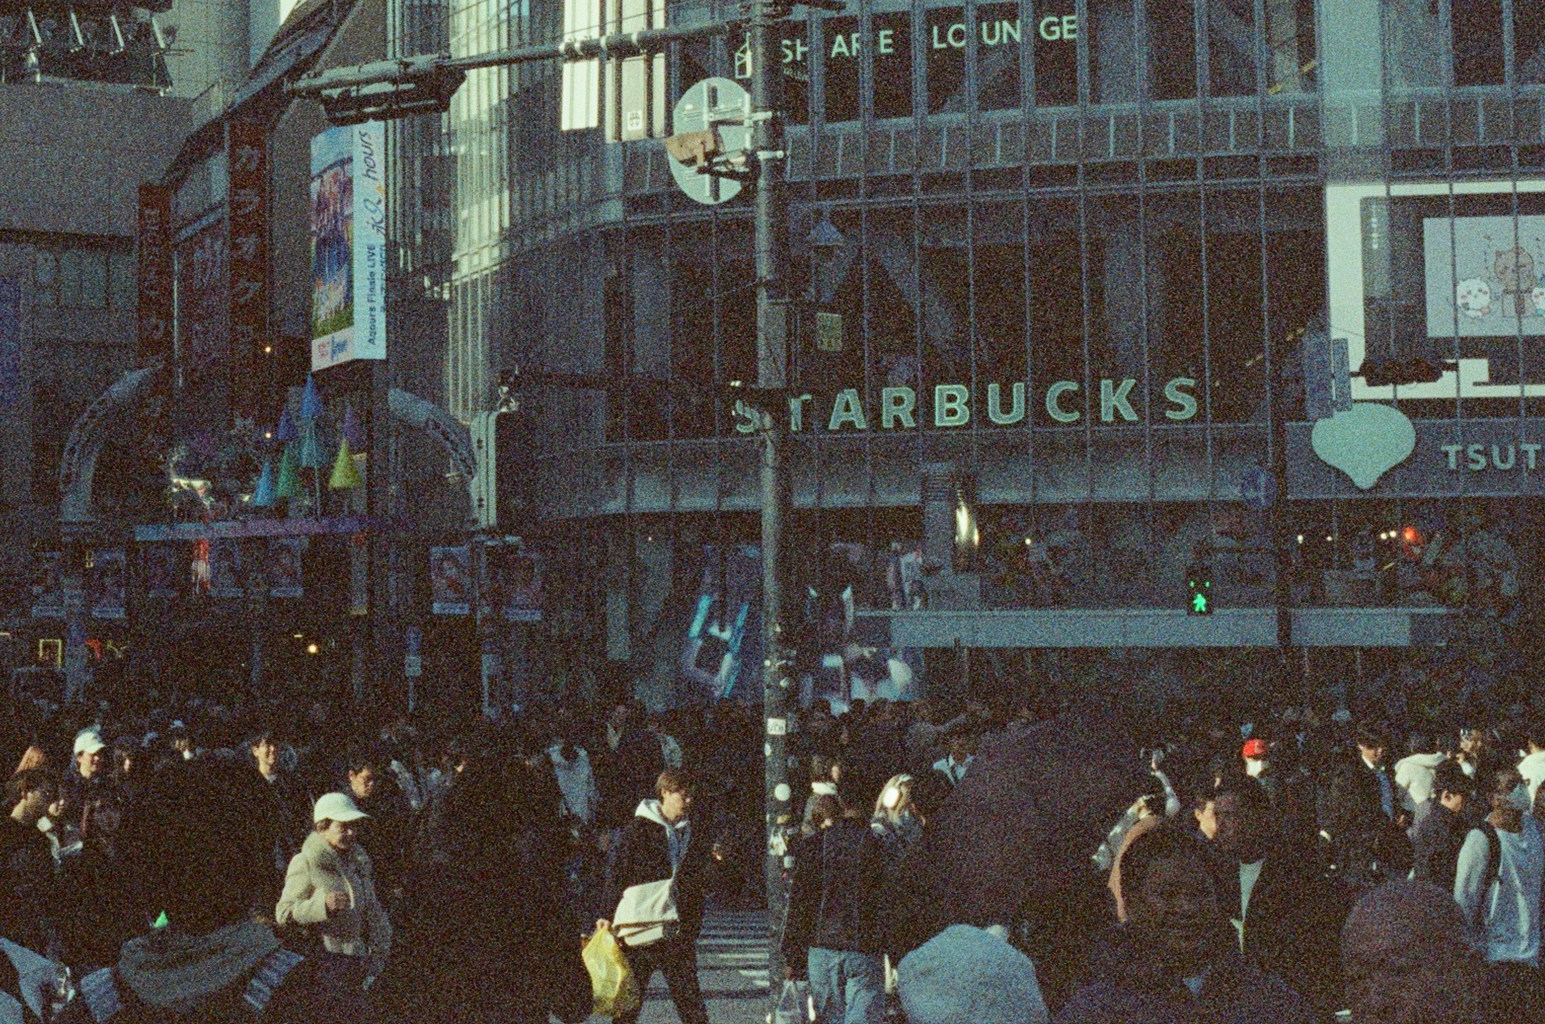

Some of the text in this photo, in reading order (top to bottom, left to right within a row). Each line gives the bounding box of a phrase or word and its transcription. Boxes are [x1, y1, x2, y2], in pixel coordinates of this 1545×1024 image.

[358, 129, 379, 183] hours
[232, 143, 264, 348] カラオケ
[366, 243, 377, 269] LIVE
